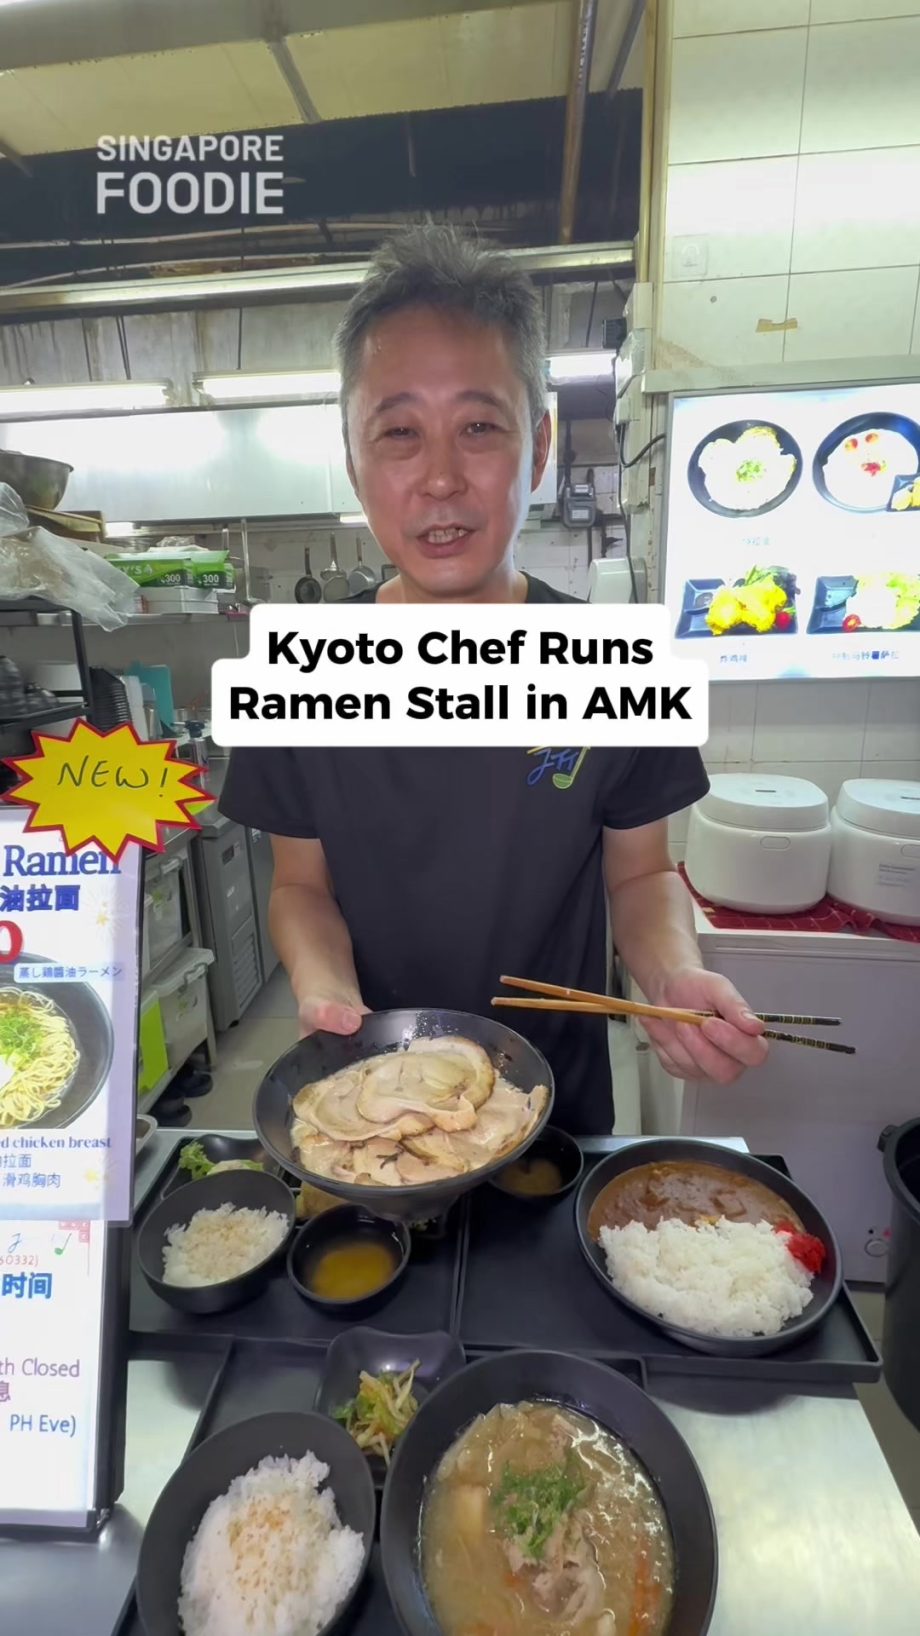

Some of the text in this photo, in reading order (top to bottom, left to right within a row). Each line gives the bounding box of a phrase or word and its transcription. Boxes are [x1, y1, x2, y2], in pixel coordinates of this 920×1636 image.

[202, 574, 220, 584] 300
[57, 755, 168, 797] NEW!
[3, 845, 121, 876] Ramen
[13, 1137, 65, 1149] chicken
[69, 1136, 111, 1149] breast
[2, 1272, 52, 1299] 时间
[22, 1358, 80, 1377] Closed
[9, 1414, 77, 1437] PH Eve)
